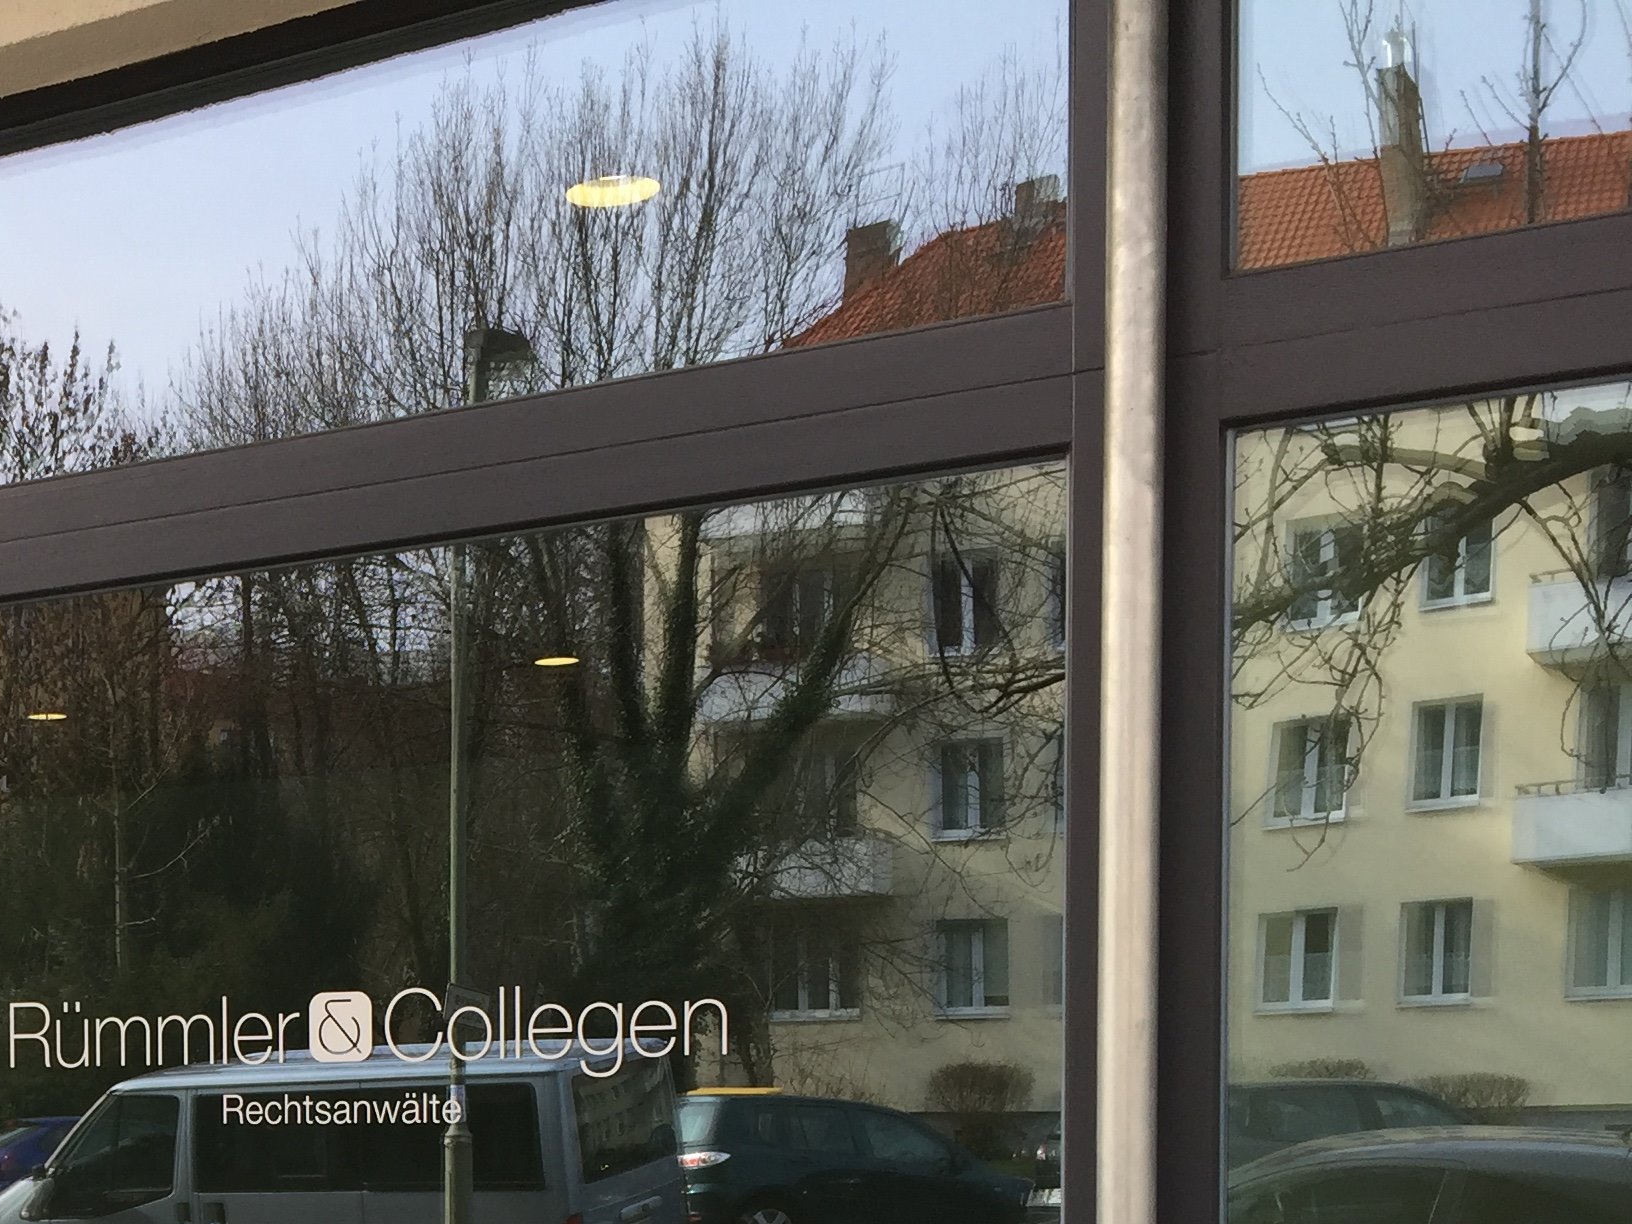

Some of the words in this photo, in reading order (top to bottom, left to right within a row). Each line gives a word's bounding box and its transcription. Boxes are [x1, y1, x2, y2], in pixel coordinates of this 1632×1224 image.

[8, 995, 302, 1069] Rümmler
[316, 996, 365, 1056] &
[383, 986, 729, 1077] Collegen
[221, 1092, 463, 1126] Rechtsanwälte
